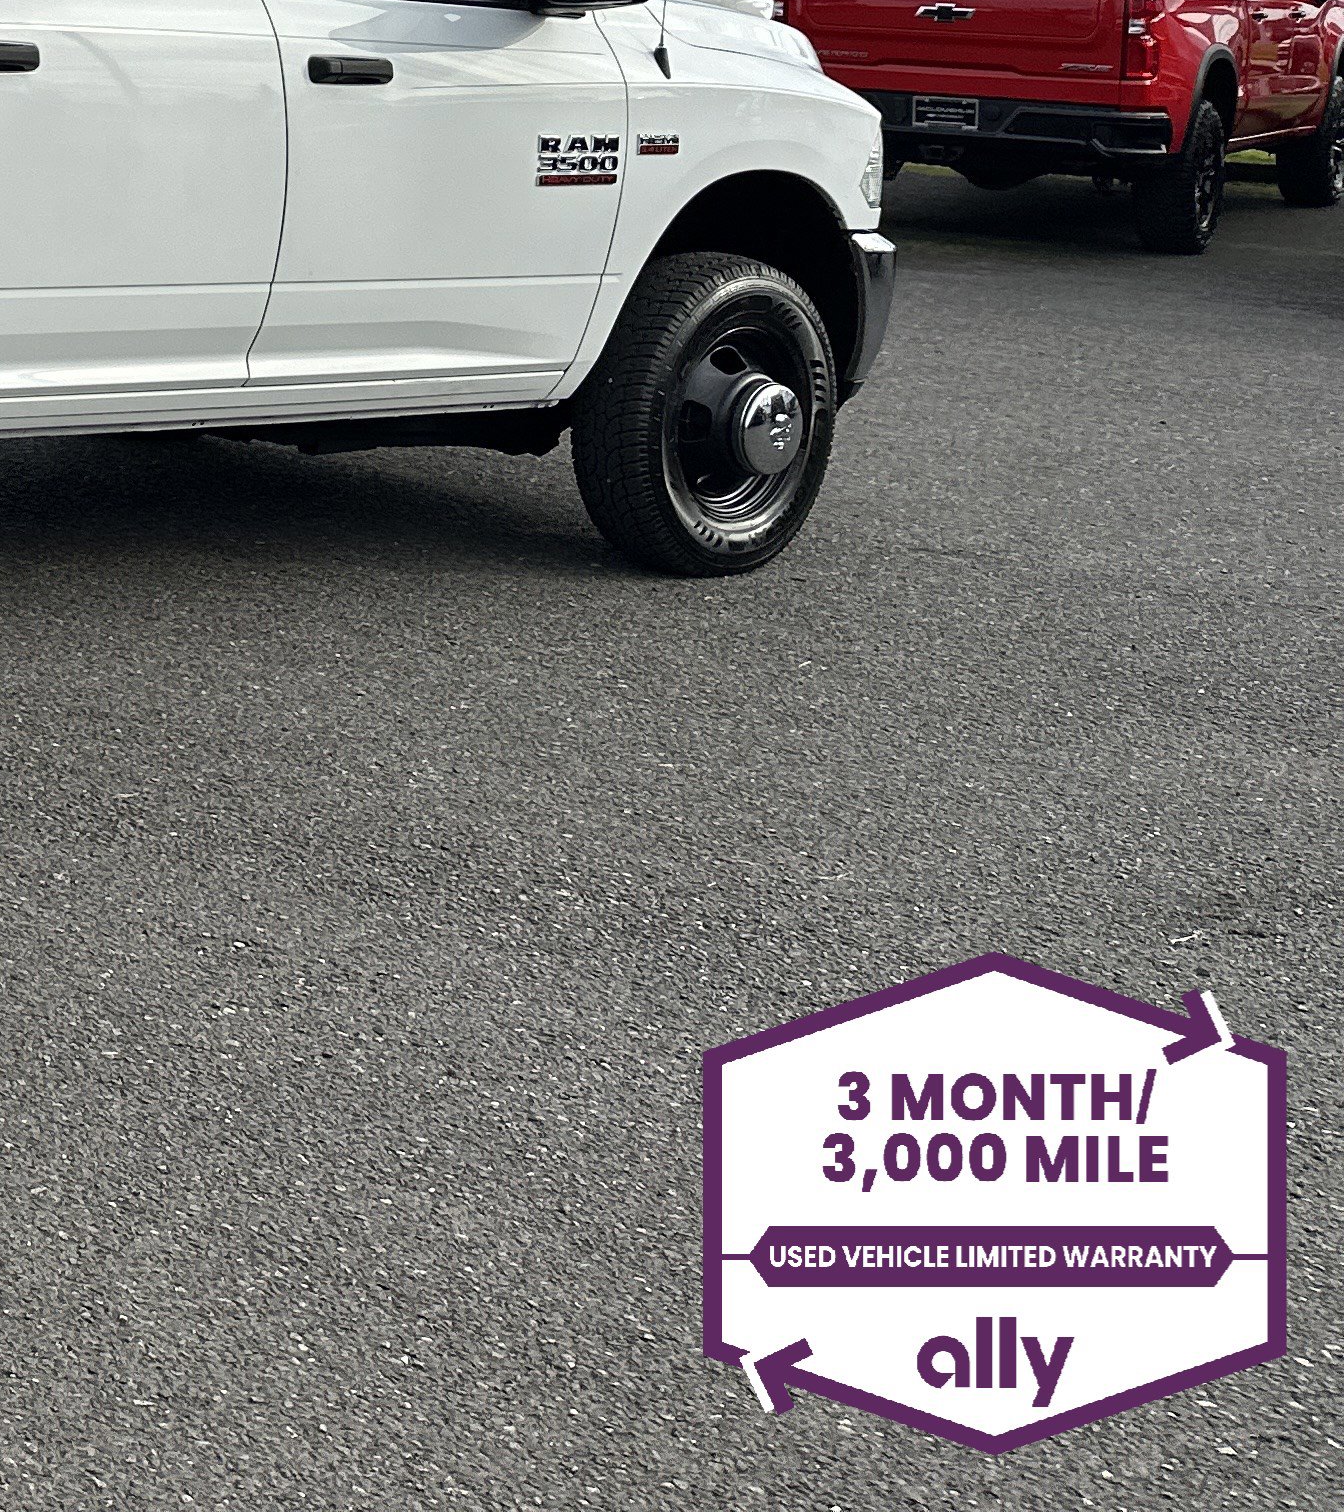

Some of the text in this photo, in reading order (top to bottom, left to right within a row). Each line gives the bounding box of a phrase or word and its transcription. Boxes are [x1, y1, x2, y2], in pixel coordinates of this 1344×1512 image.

[537, 134, 620, 153] RAM
[537, 153, 619, 173] 3500
[542, 175, 614, 184] HEAVY DUTY
